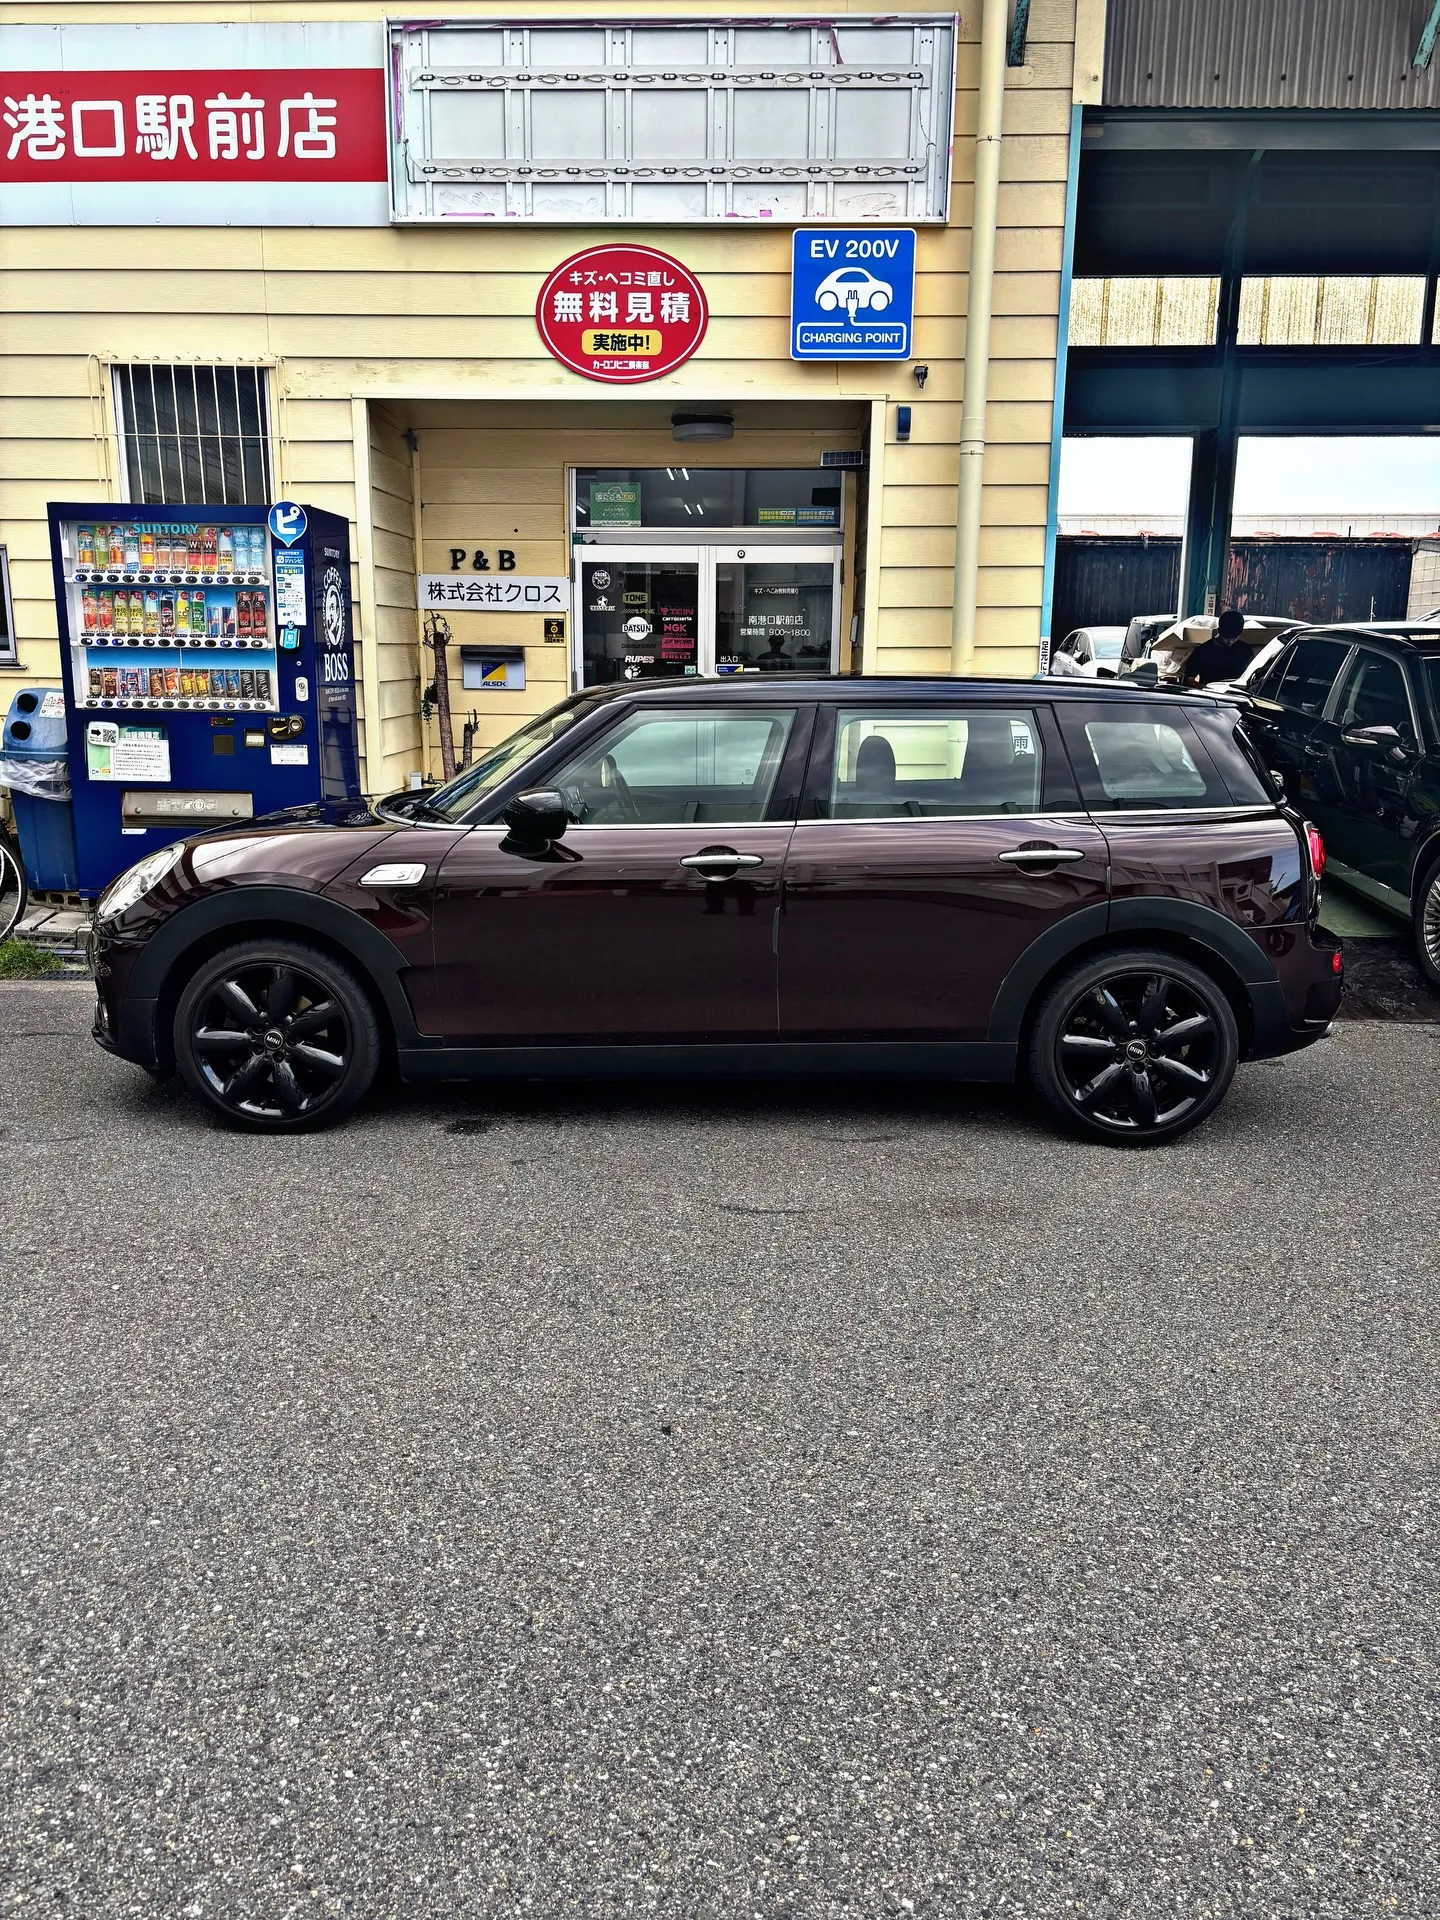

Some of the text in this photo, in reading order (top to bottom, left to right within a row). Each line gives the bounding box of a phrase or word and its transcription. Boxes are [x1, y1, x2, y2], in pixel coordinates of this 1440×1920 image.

[2, 92, 338, 160] 港口駅前店
[810, 238, 900, 259] EV 200V
[569, 270, 675, 287] キズ・ヘコミ直し
[553, 291, 691, 324] 無料見積
[592, 333, 650, 352] 実施中!
[801, 332, 901, 344] CHARGING POINT
[133, 523, 199, 535] SUNTORY
[275, 505, 301, 535] ピ
[450, 548, 516, 571] P & B
[427, 581, 562, 603] 株式会社クロス
[624, 594, 646, 602] TONE
[623, 624, 652, 632] DATSUN
[663, 623, 687, 632] NGK
[748, 615, 804, 625] 南港口駅前店
[624, 655, 655, 663] RUPES
[1040, 640, 1049, 674] 足元に
[323, 652, 349, 682] BOSS
